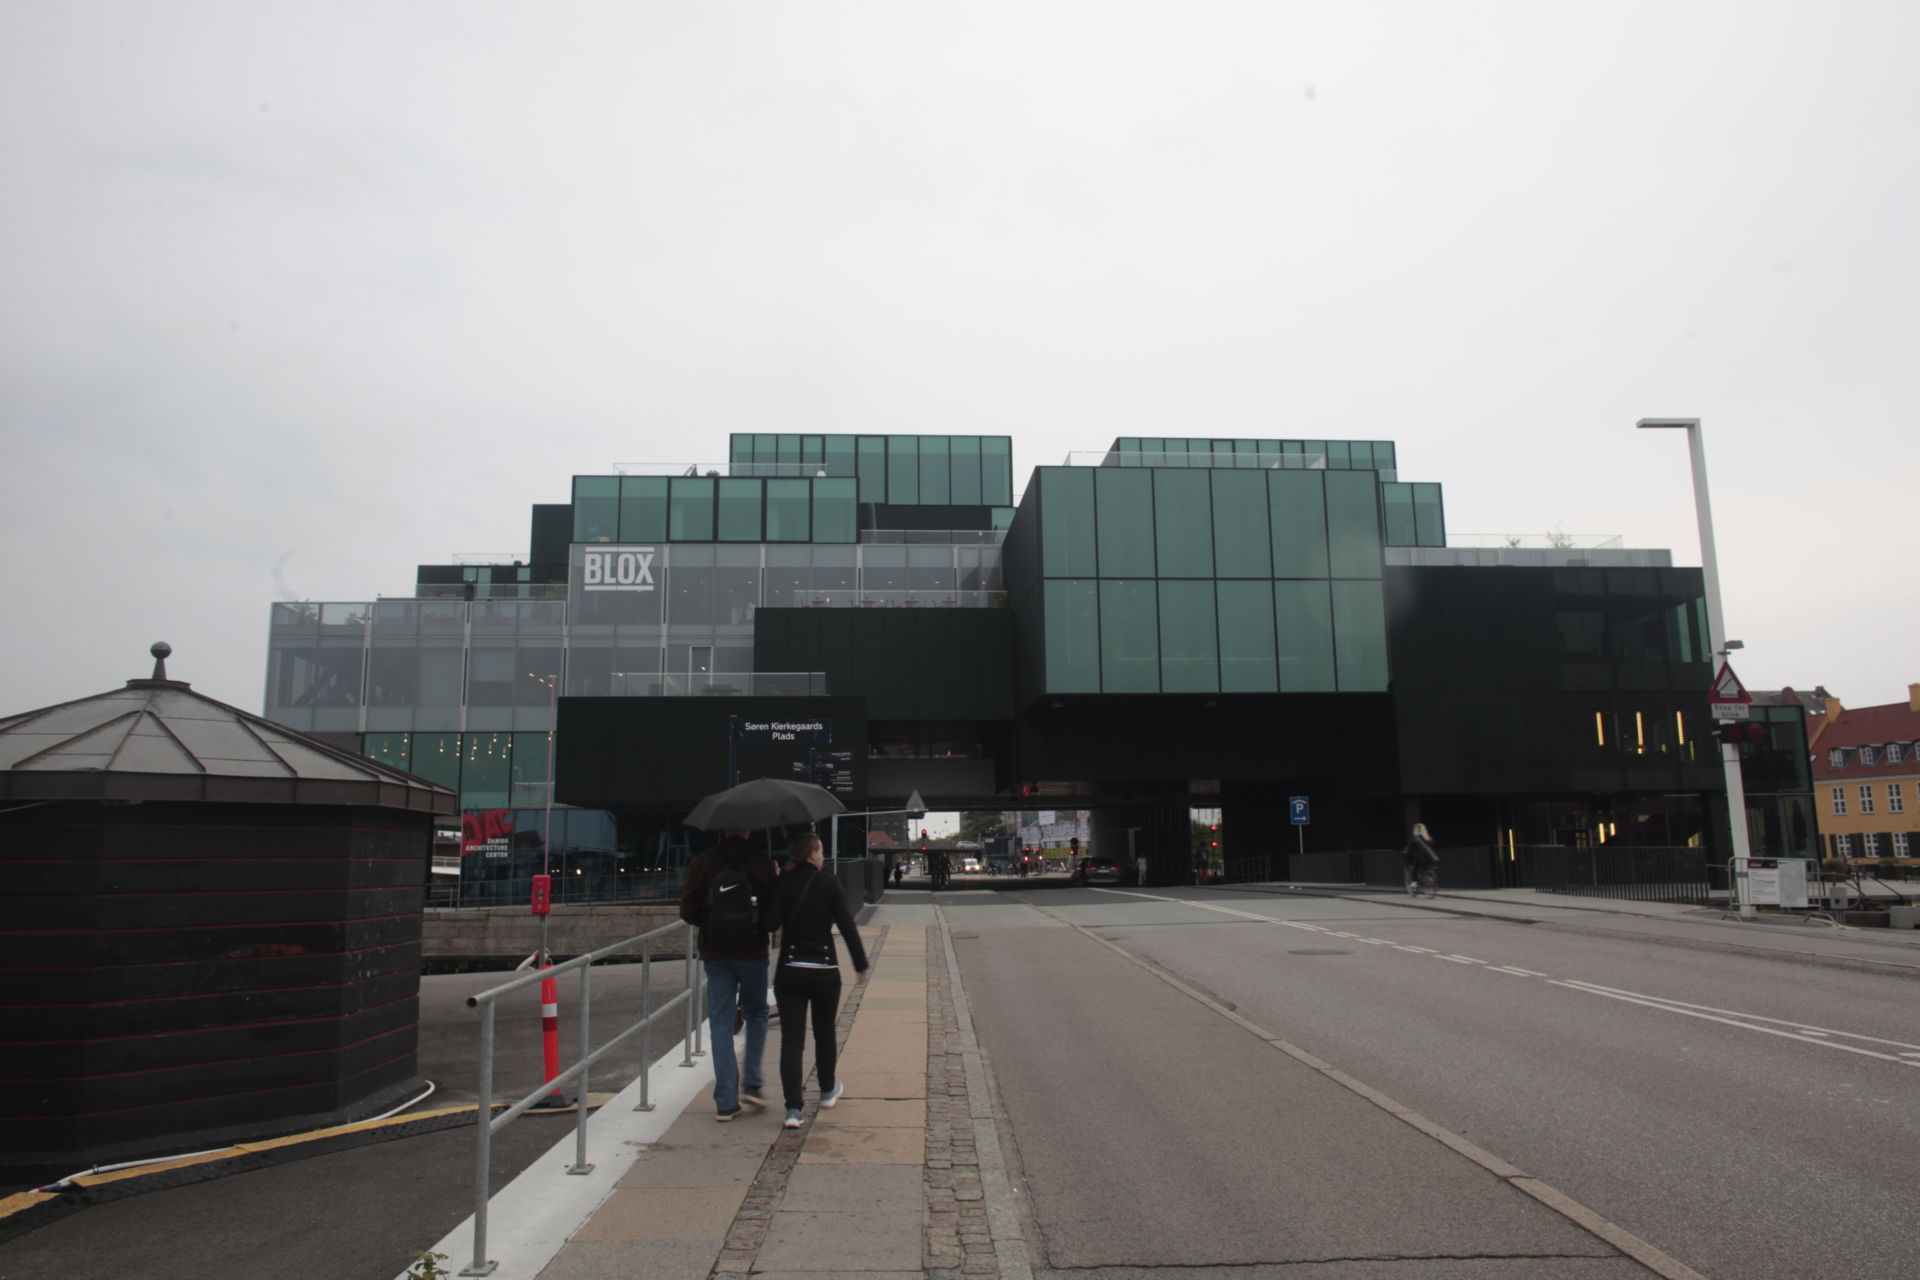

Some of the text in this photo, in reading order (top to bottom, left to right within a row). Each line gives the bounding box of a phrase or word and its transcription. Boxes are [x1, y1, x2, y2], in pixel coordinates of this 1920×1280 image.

[584, 553, 655, 585] BLOX
[744, 722, 823, 731] Søren Kierkegaards
[772, 732, 795, 740] Plads
[1296, 803, 1304, 815] P
